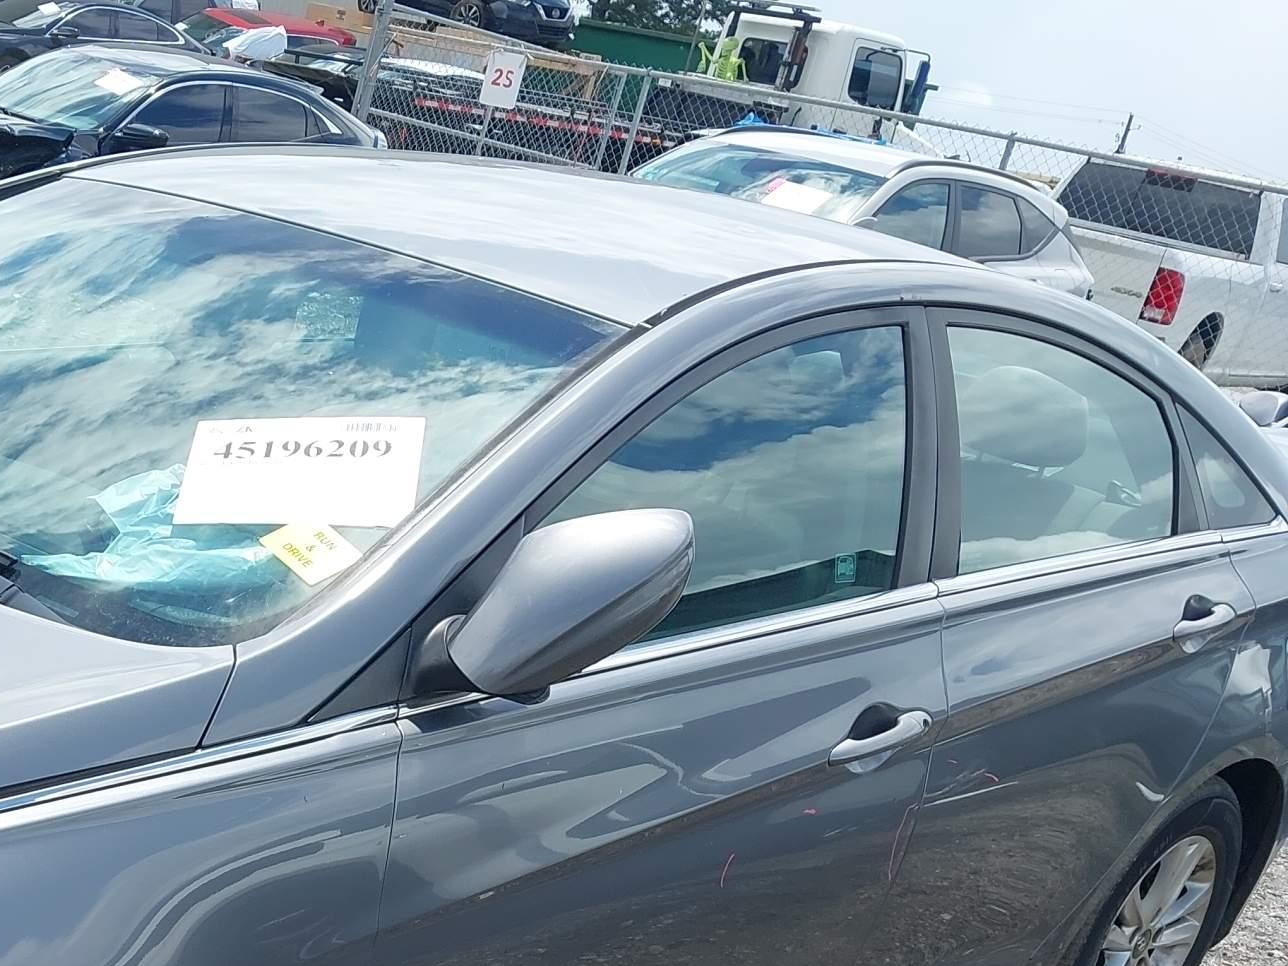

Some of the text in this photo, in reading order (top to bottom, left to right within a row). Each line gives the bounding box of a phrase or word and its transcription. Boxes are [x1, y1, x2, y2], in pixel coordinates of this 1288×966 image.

[213, 439, 393, 459] 45196209
[314, 531, 337, 550] RUN
[282, 542, 313, 568] DRIVE
